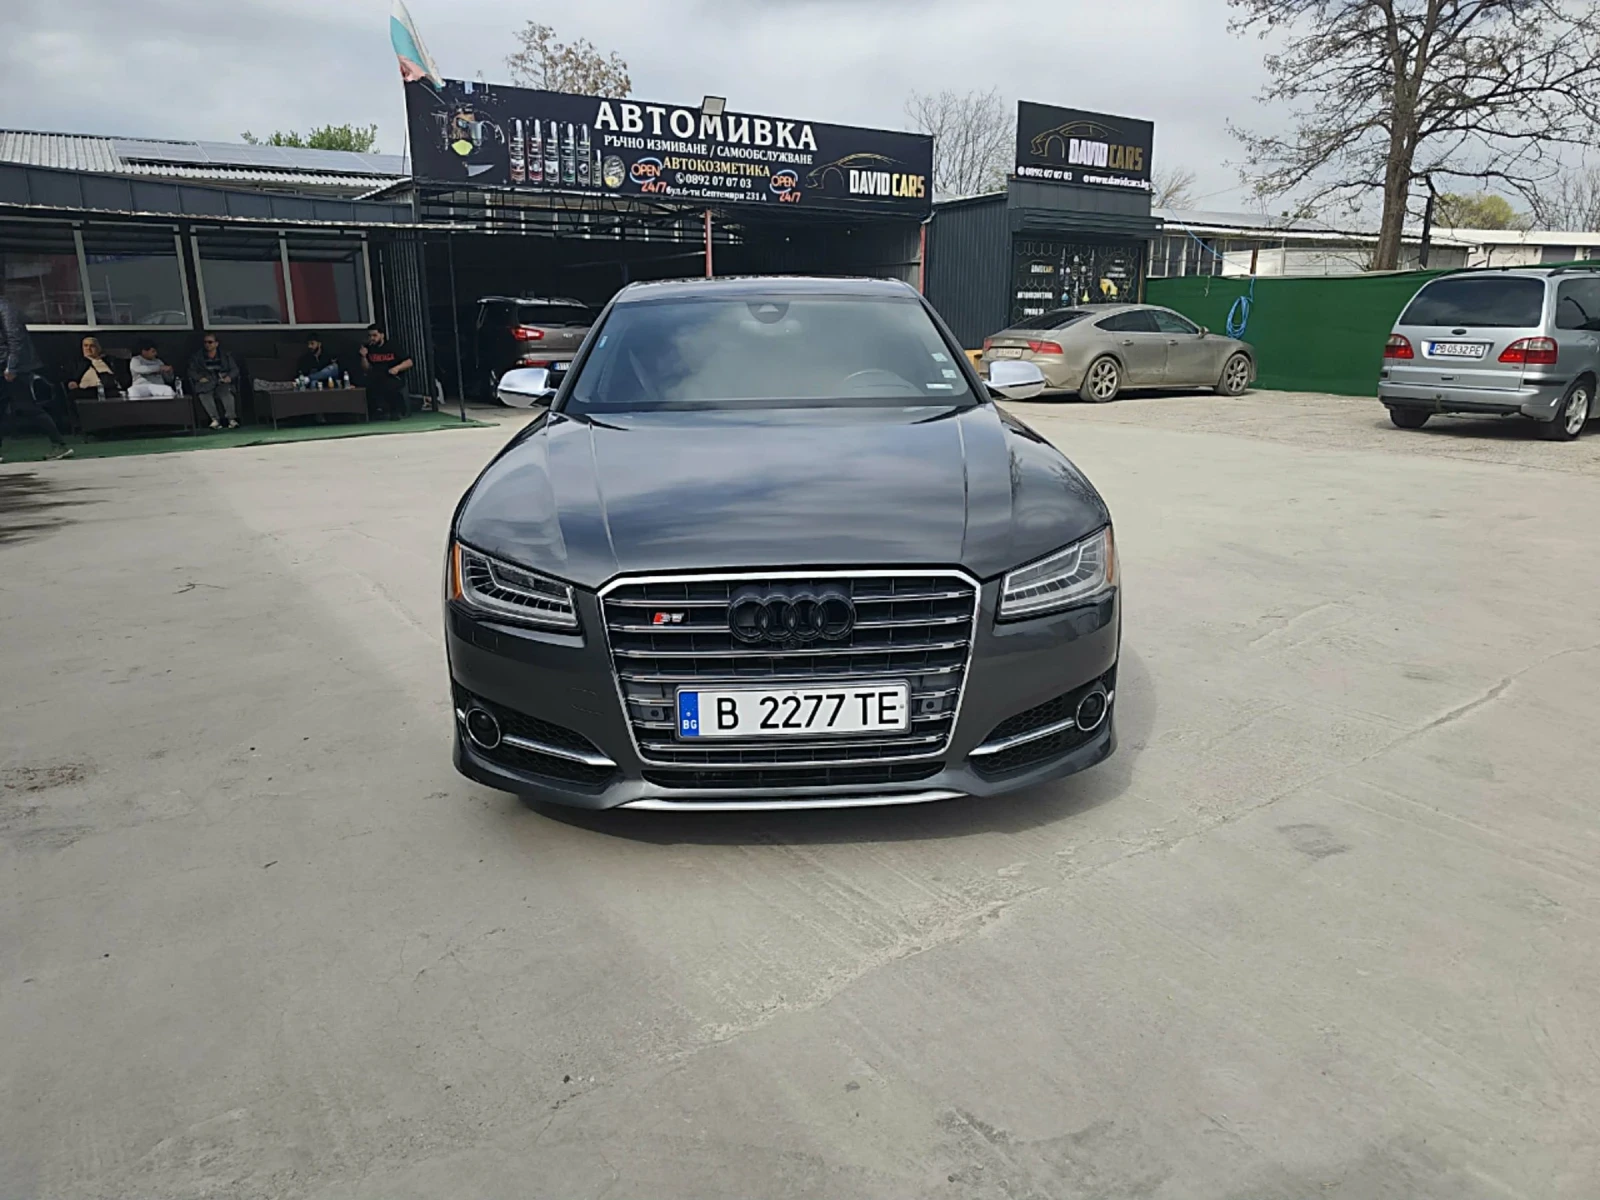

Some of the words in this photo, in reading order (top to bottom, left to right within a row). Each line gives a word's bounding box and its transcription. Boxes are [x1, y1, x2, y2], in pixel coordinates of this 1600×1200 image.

[594, 101, 818, 151] АВТОМИВКА
[604, 134, 645, 149] РЪЧНО
[646, 138, 708, 155] ИЗМИВАНЕ
[709, 145, 715, 158] /
[717, 146, 813, 164] САМООБСЛУЖВАНЕ
[1068, 138, 1108, 167] DAVID
[1108, 144, 1143, 171] CARS
[631, 163, 661, 177] OPEN
[663, 156, 770, 177] АВТОКОЗМЕТИКА
[641, 181, 667, 193] 24/7
[685, 173, 710, 185] 0892
[712, 175, 724, 186] 07
[726, 177, 738, 188] 07
[740, 179, 752, 189] 03
[771, 175, 796, 188] OPEN
[849, 169, 890, 196] DAVID
[891, 173, 926, 198] CARS
[701, 188, 744, 202] Септември
[746, 191, 760, 201] 231
[779, 192, 801, 203] 24/7
[1435, 344, 1447, 354] PB
[1447, 345, 1469, 355] 0532
[1469, 346, 1482, 356] PE
[716, 697, 739, 730] B
[759, 694, 846, 729] 2277
[854, 691, 899, 725] TE
[683, 719, 697, 730] BG
